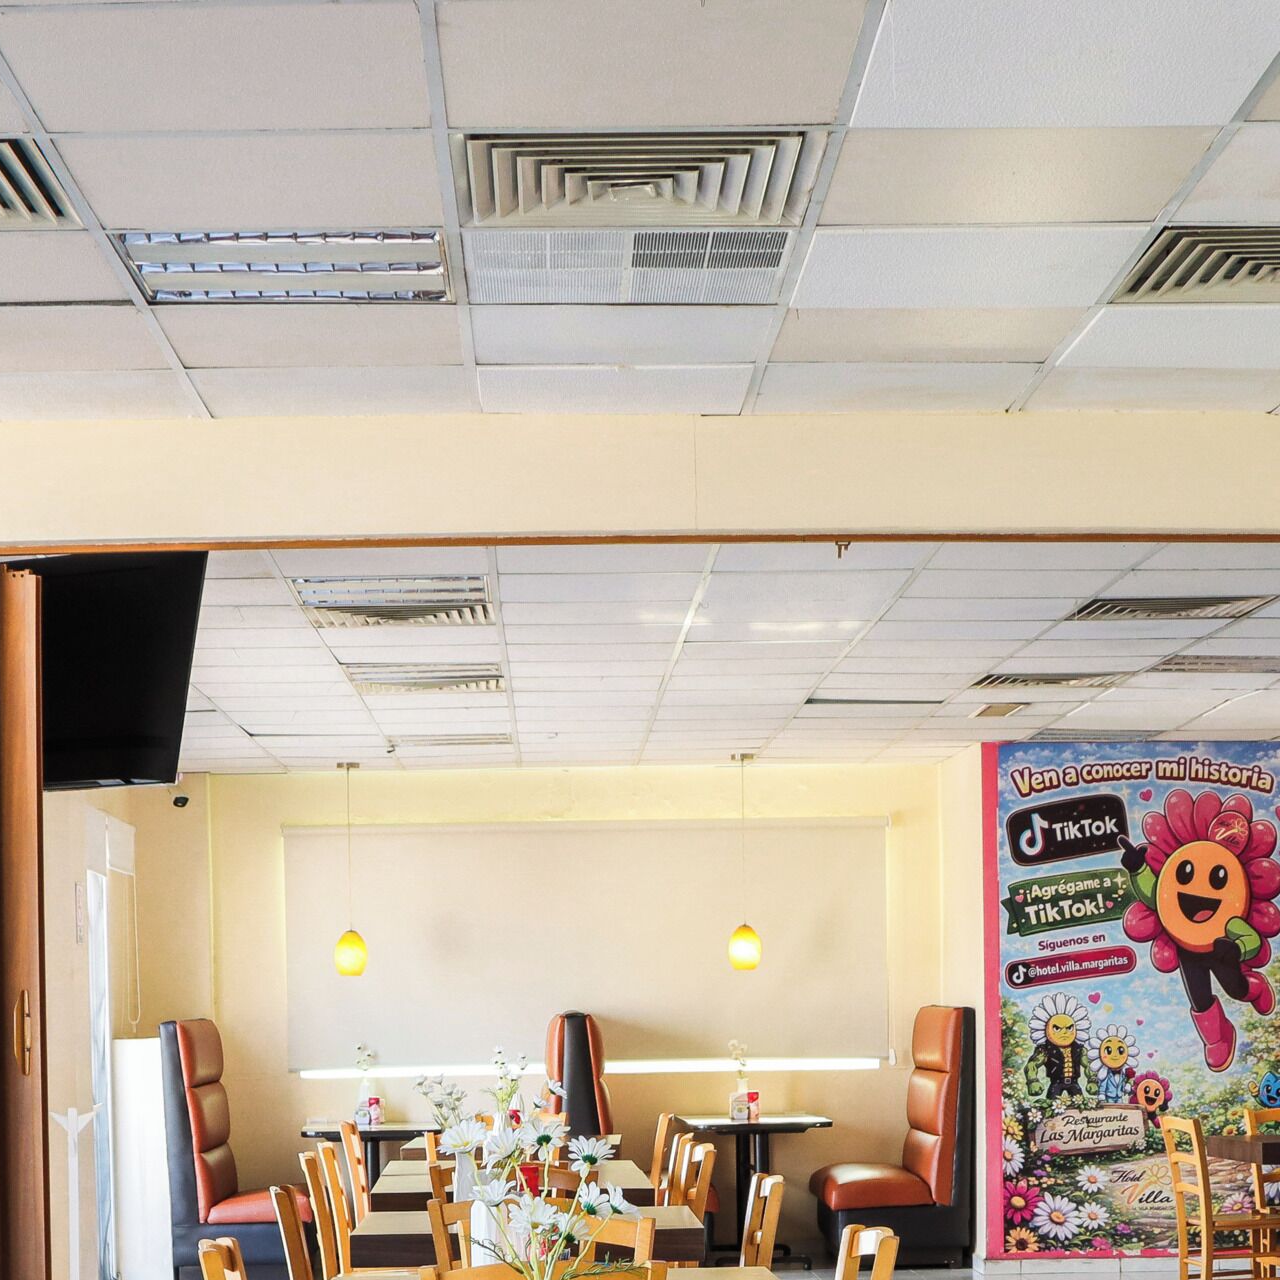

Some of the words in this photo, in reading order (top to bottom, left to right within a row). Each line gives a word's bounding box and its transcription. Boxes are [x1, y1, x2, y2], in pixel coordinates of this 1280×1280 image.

[1011, 767, 1061, 797] Ven
[1063, 766, 1079, 786] a
[1081, 762, 1152, 783] conocer
[1156, 757, 1186, 781] mi
[1189, 757, 1274, 793] historia
[1052, 816, 1119, 841] TikTok
[1026, 879, 1100, 903] ¡Agrégame
[1103, 877, 1111, 887] a
[1024, 893, 1105, 925] TikTok!
[1038, 936, 1089, 951] Síguenos
[1093, 934, 1106, 943] en
[1028, 955, 1129, 978] @hotel.villa.margaritas
[1062, 1113, 1128, 1128] Restaurante
[1040, 1130, 1064, 1144] Las
[1063, 1125, 1140, 1144] Margaritas
[1110, 1170, 1146, 1183] Hotel
[1121, 1182, 1173, 1204] Villa
